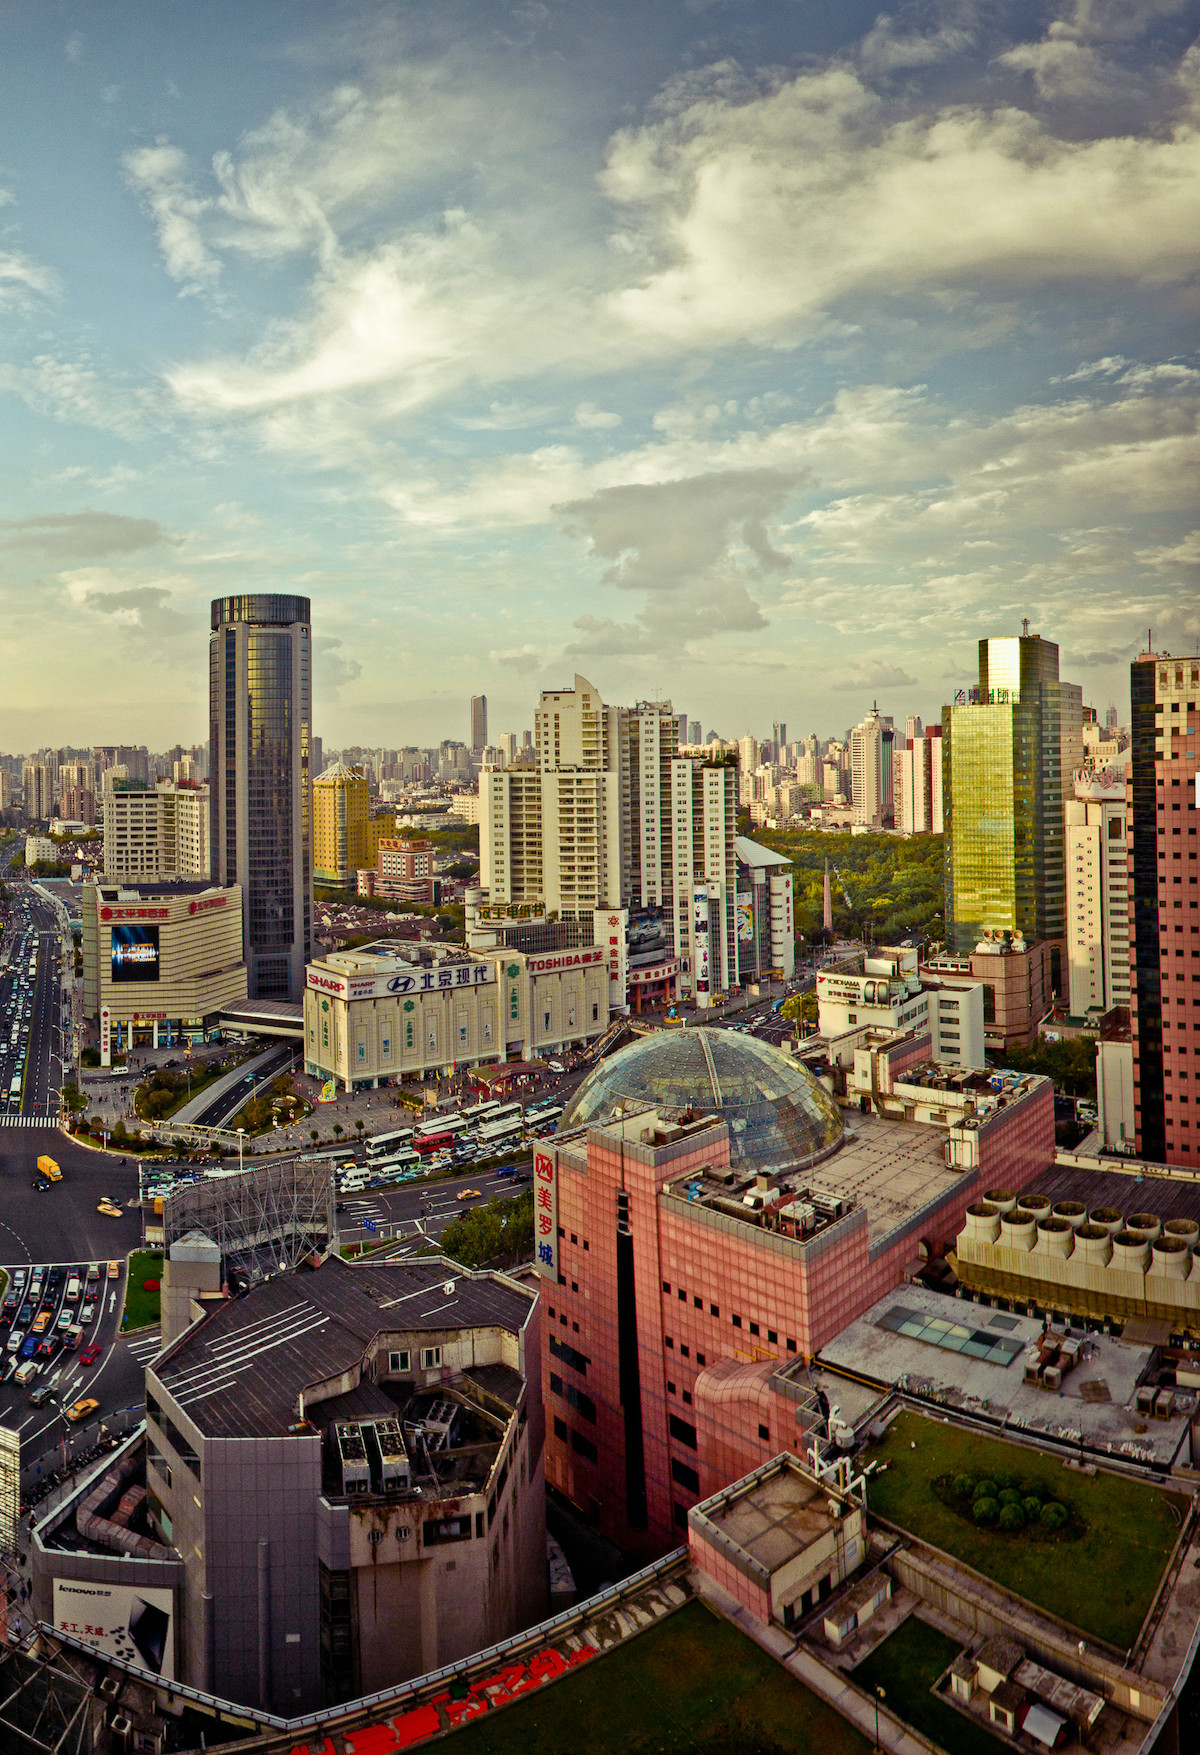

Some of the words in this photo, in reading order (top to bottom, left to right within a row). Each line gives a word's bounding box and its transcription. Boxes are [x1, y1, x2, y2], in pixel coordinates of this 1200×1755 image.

[478, 902, 544, 920] 汉王电纸书
[529, 954, 580, 972] TOSHIBA
[308, 973, 345, 993] SHARP
[420, 965, 488, 990] 北京现代
[826, 978, 860, 988] YOKOHAMA
[537, 1186, 554, 1268] 美罗城
[59, 1585, 96, 1596] lenovo
